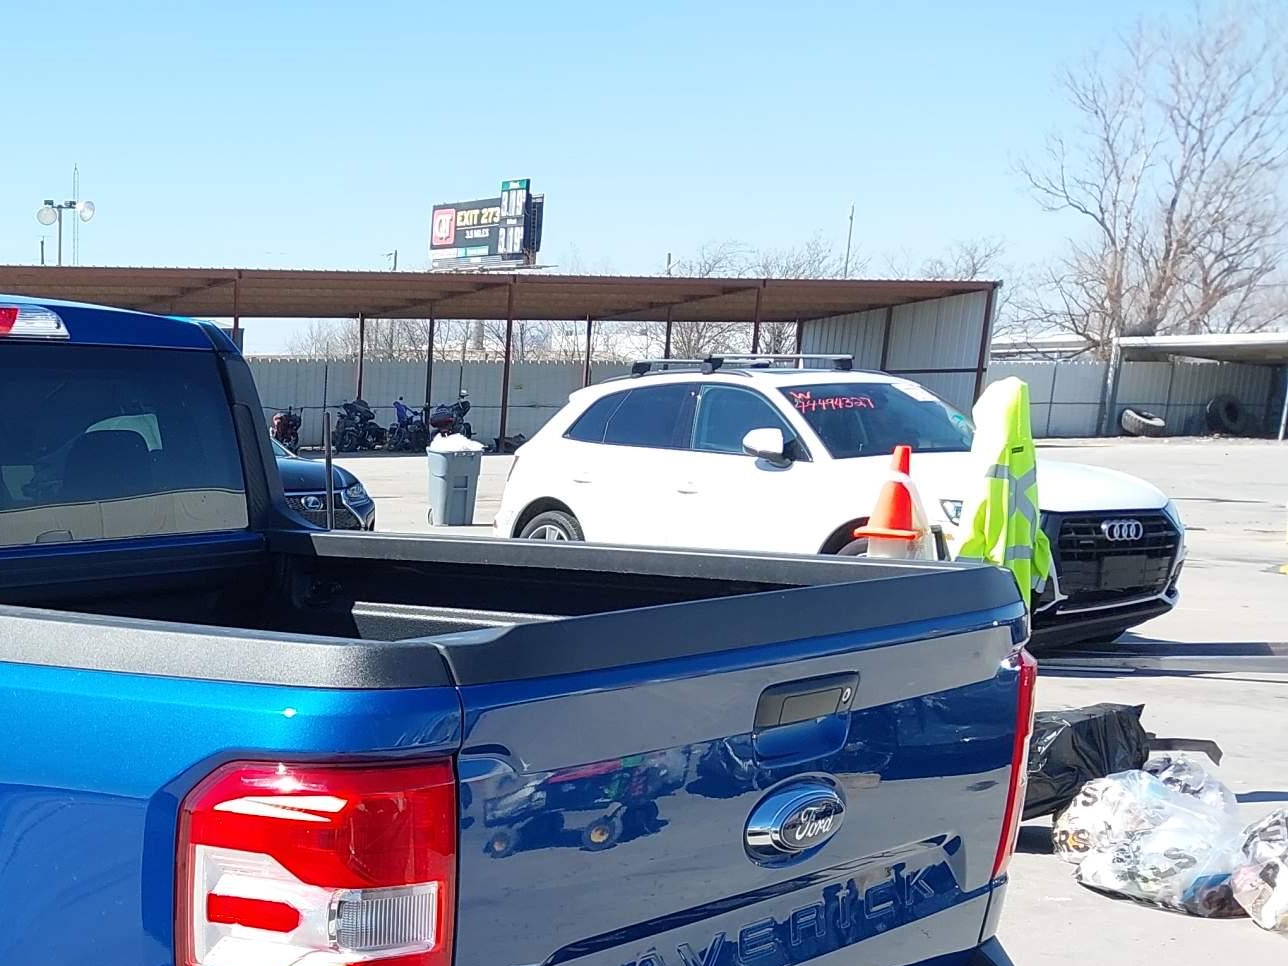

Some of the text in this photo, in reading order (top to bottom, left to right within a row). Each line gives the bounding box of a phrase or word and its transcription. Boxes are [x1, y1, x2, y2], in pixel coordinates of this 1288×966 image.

[456, 206, 501, 227] EXIT 273
[794, 805, 834, 842] Ford
